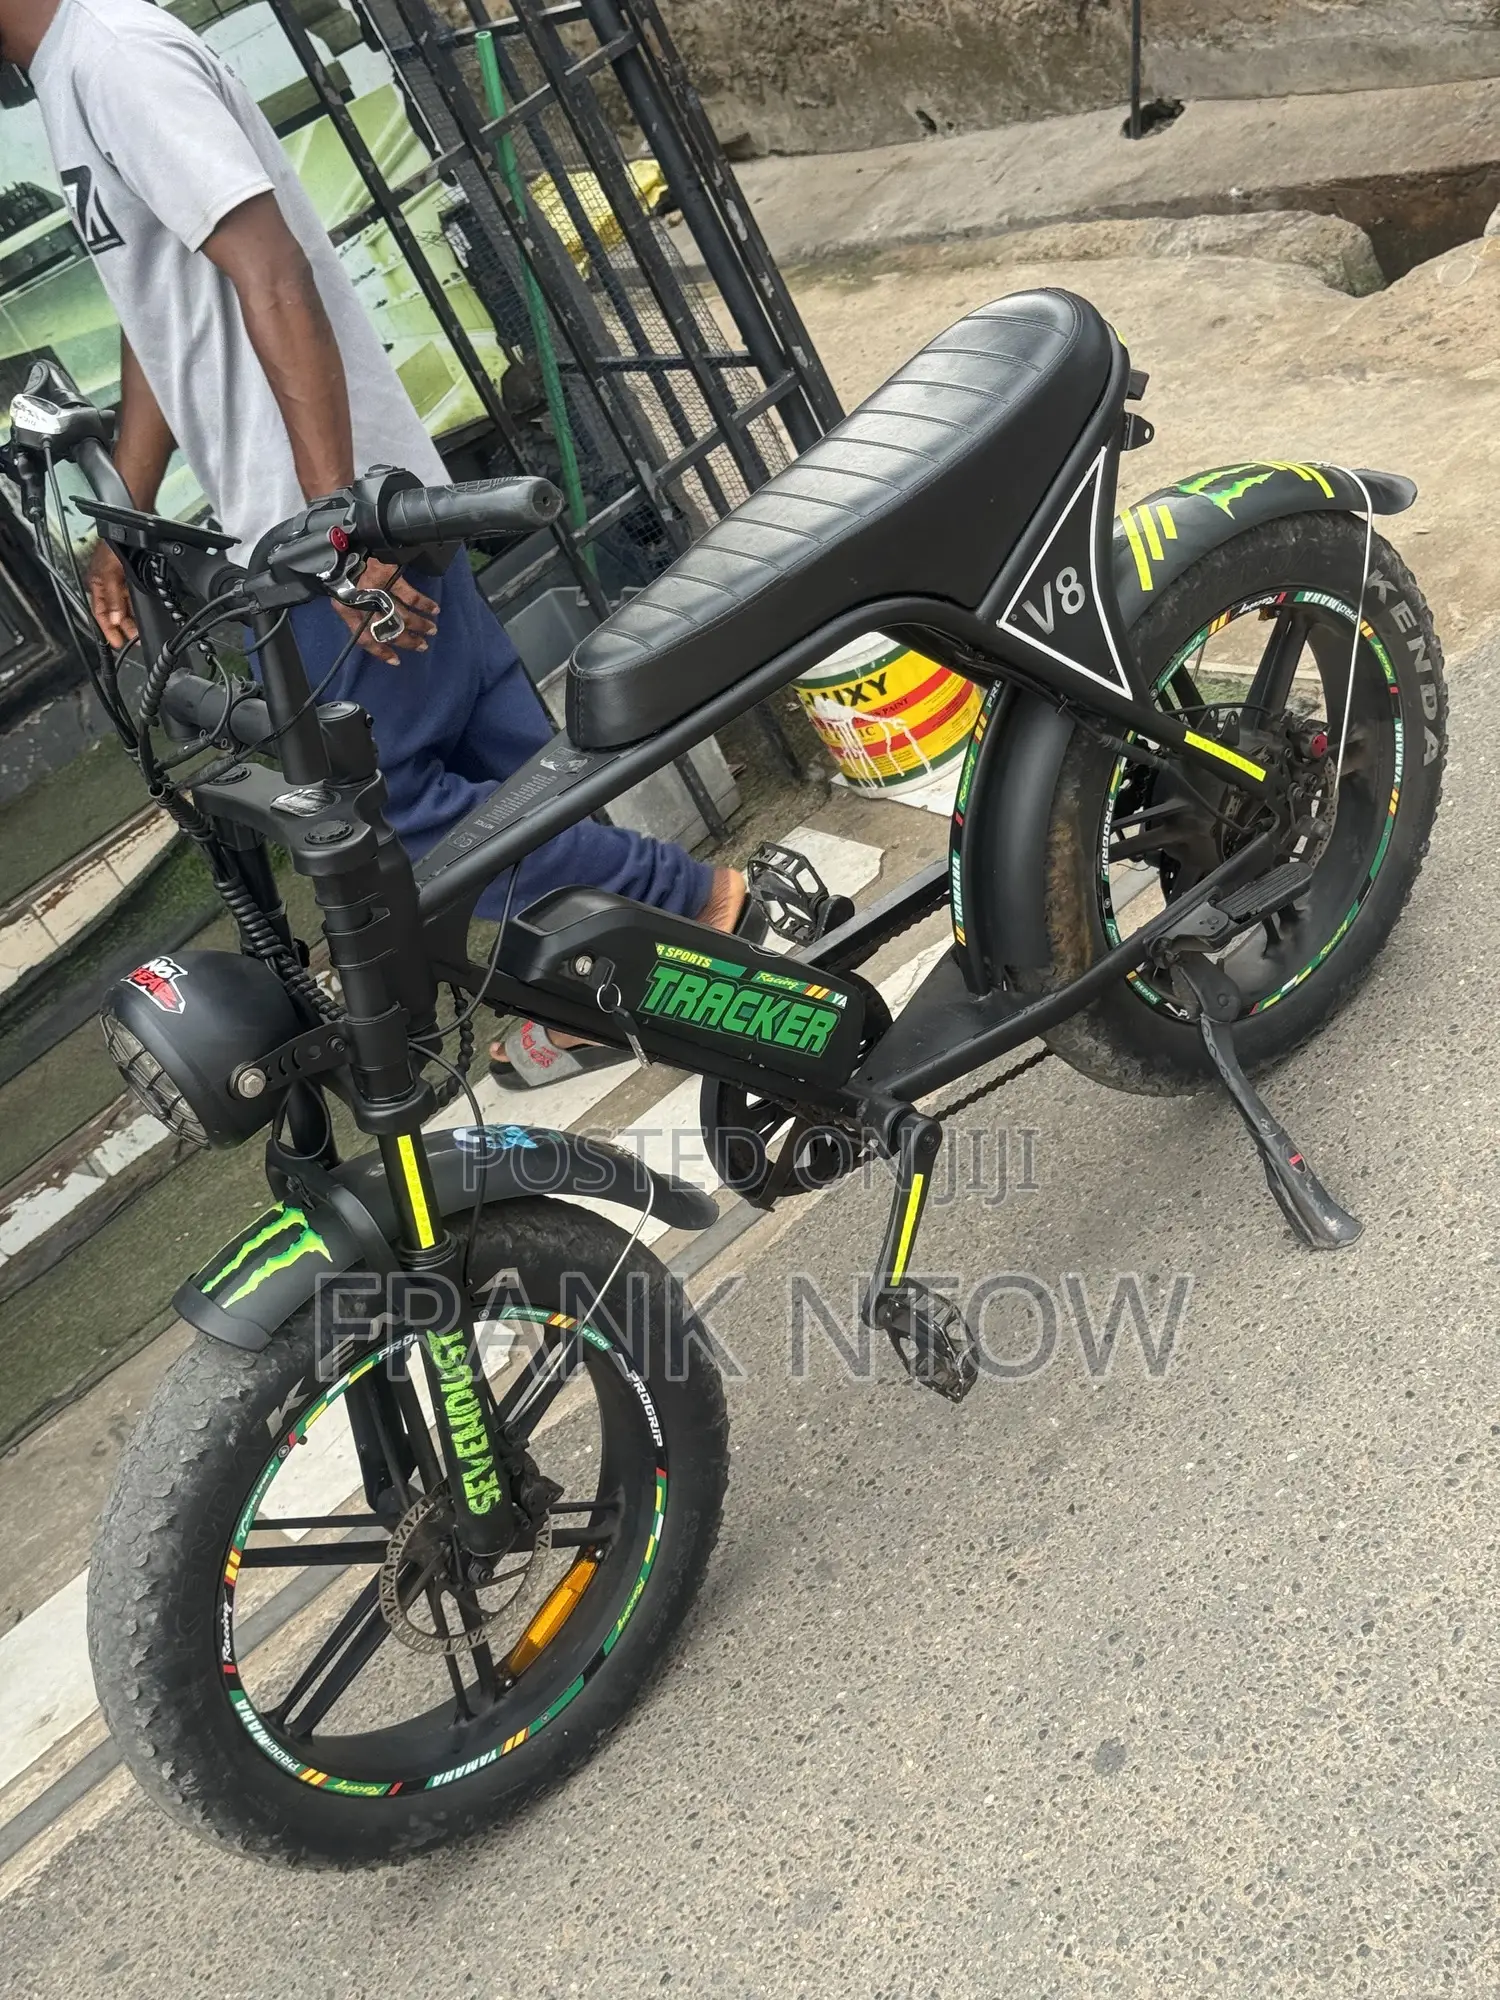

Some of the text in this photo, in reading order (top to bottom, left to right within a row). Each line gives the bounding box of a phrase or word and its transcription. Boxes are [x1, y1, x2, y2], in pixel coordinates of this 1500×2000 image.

[1021, 566, 1086, 636] V8
[1366, 569, 1440, 767] KENDA
[1394, 722, 1404, 784] YAMAHA
[1101, 799, 1116, 876] PROGRIP
[952, 856, 964, 922] YAMAHA
[665, 945, 713, 968] SPORTS
[757, 972, 799, 989] Racing
[644, 965, 838, 1053] TRACKER
[580, 1326, 610, 1350] EPSOL
[425, 1329, 503, 1516] SEVENDUST
[626, 1369, 664, 1448] PROGRIP
[220, 1601, 233, 1662] Racing
[334, 1779, 385, 1796] Racing
[431, 1748, 497, 1787] YAMAHA
